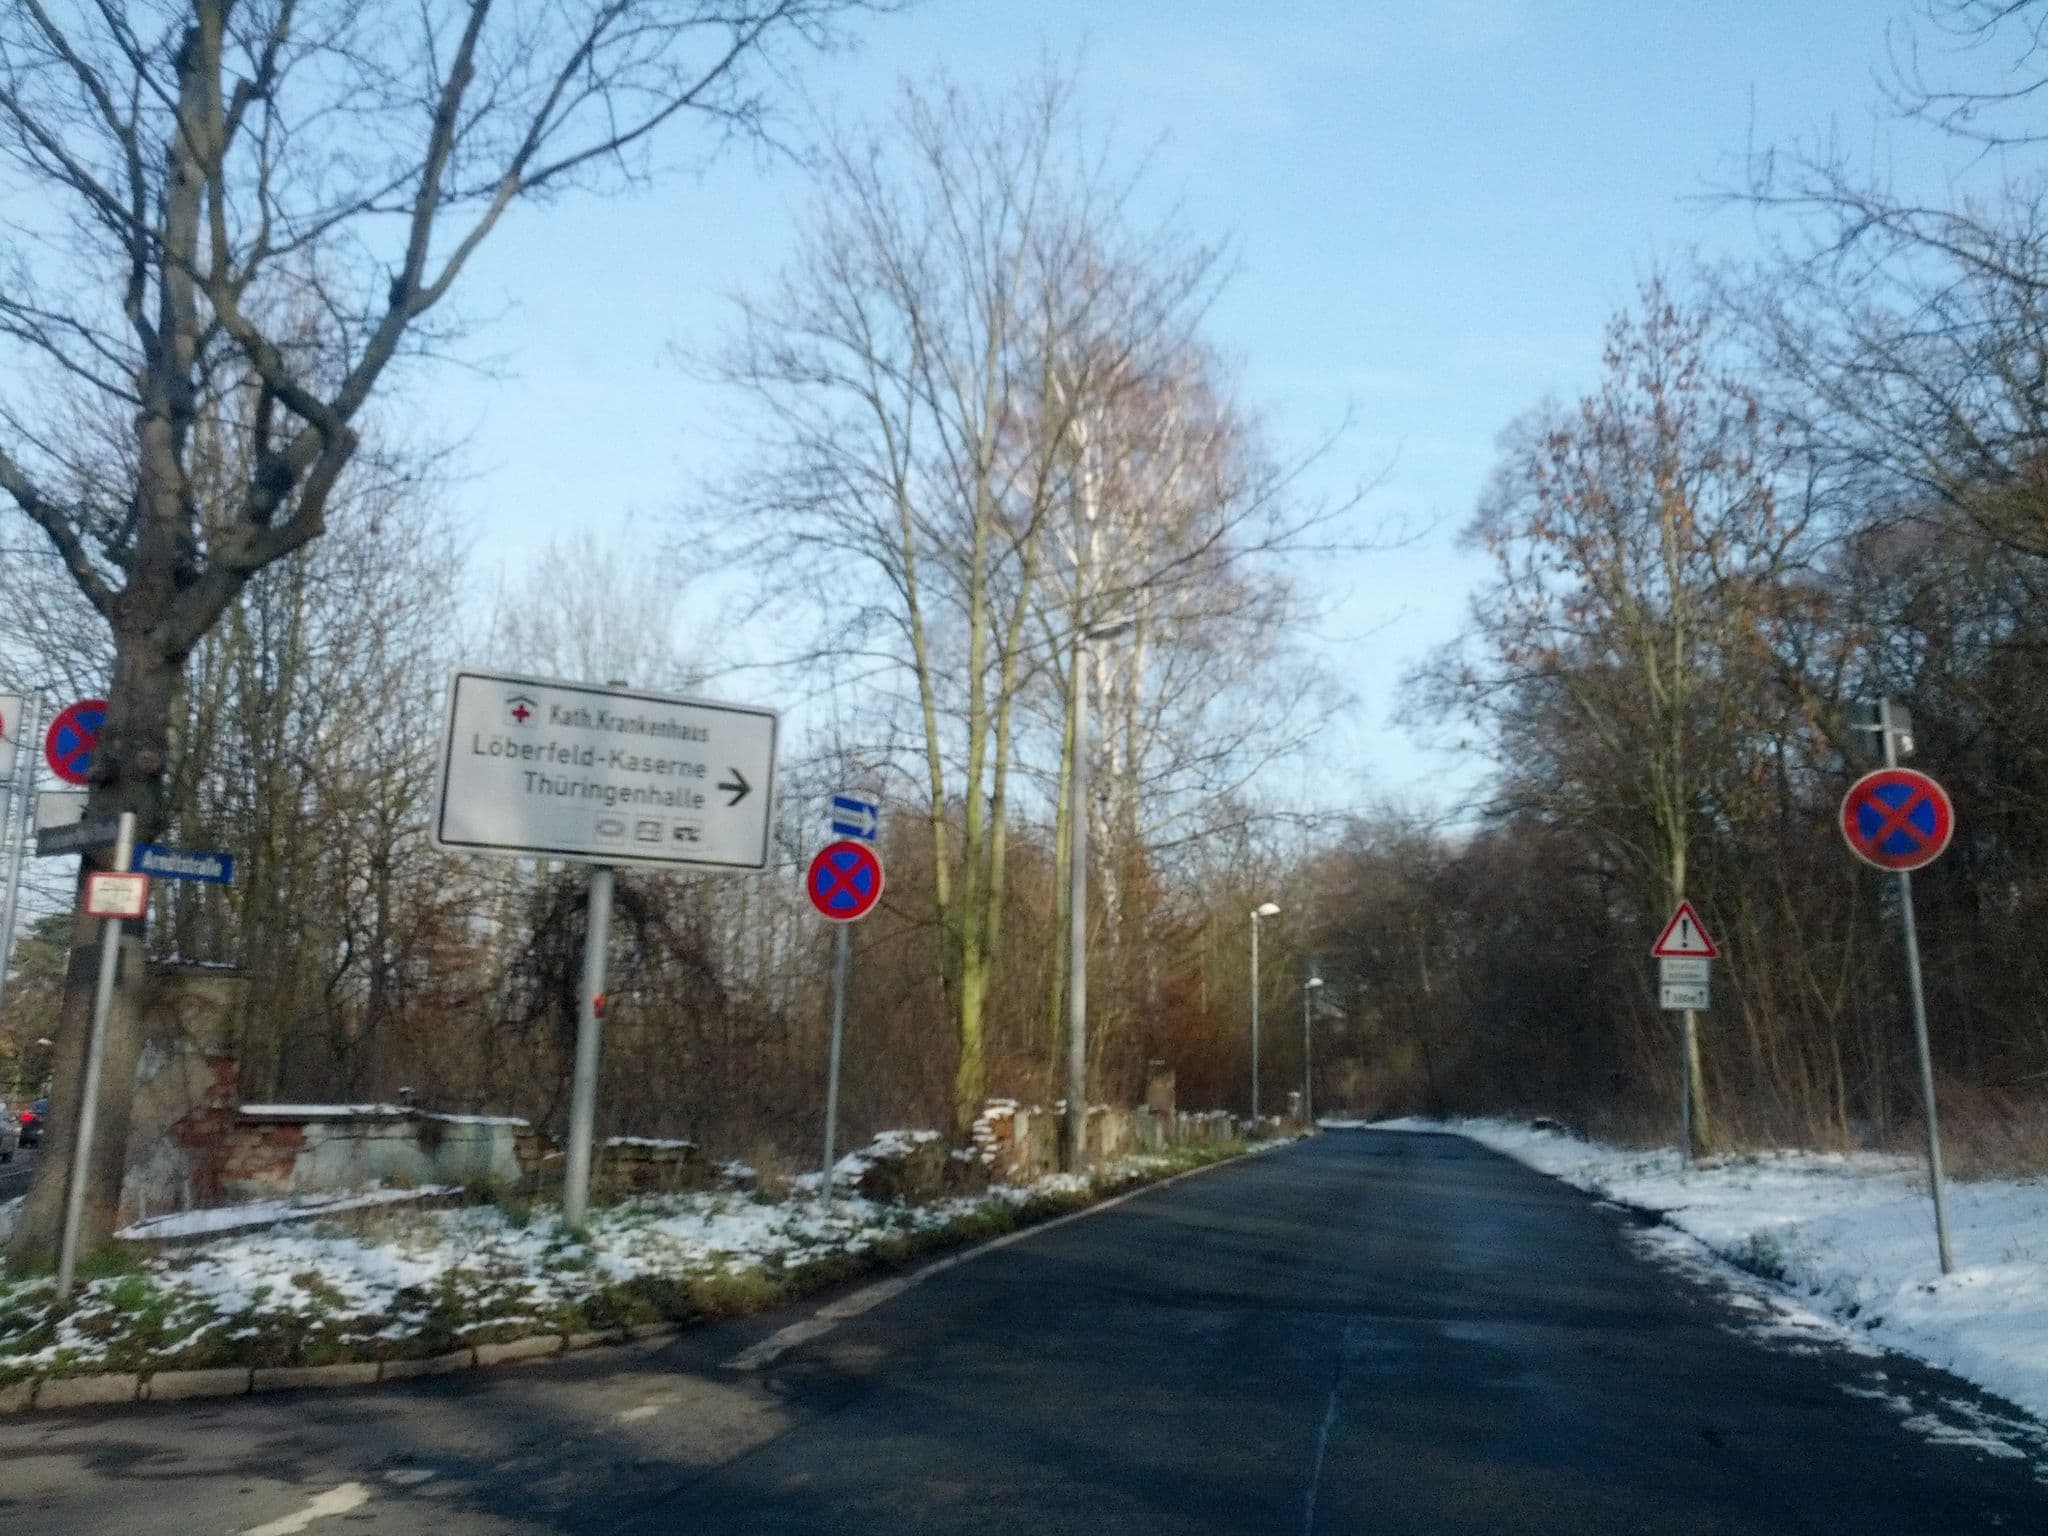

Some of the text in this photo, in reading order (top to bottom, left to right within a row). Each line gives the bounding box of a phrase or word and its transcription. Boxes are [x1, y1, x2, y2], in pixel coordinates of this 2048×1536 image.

[598, 709, 710, 743] Krankenhaus
[472, 733, 707, 779] Löberfeld-Kaserne
[525, 771, 706, 810] Thüringenhalle
